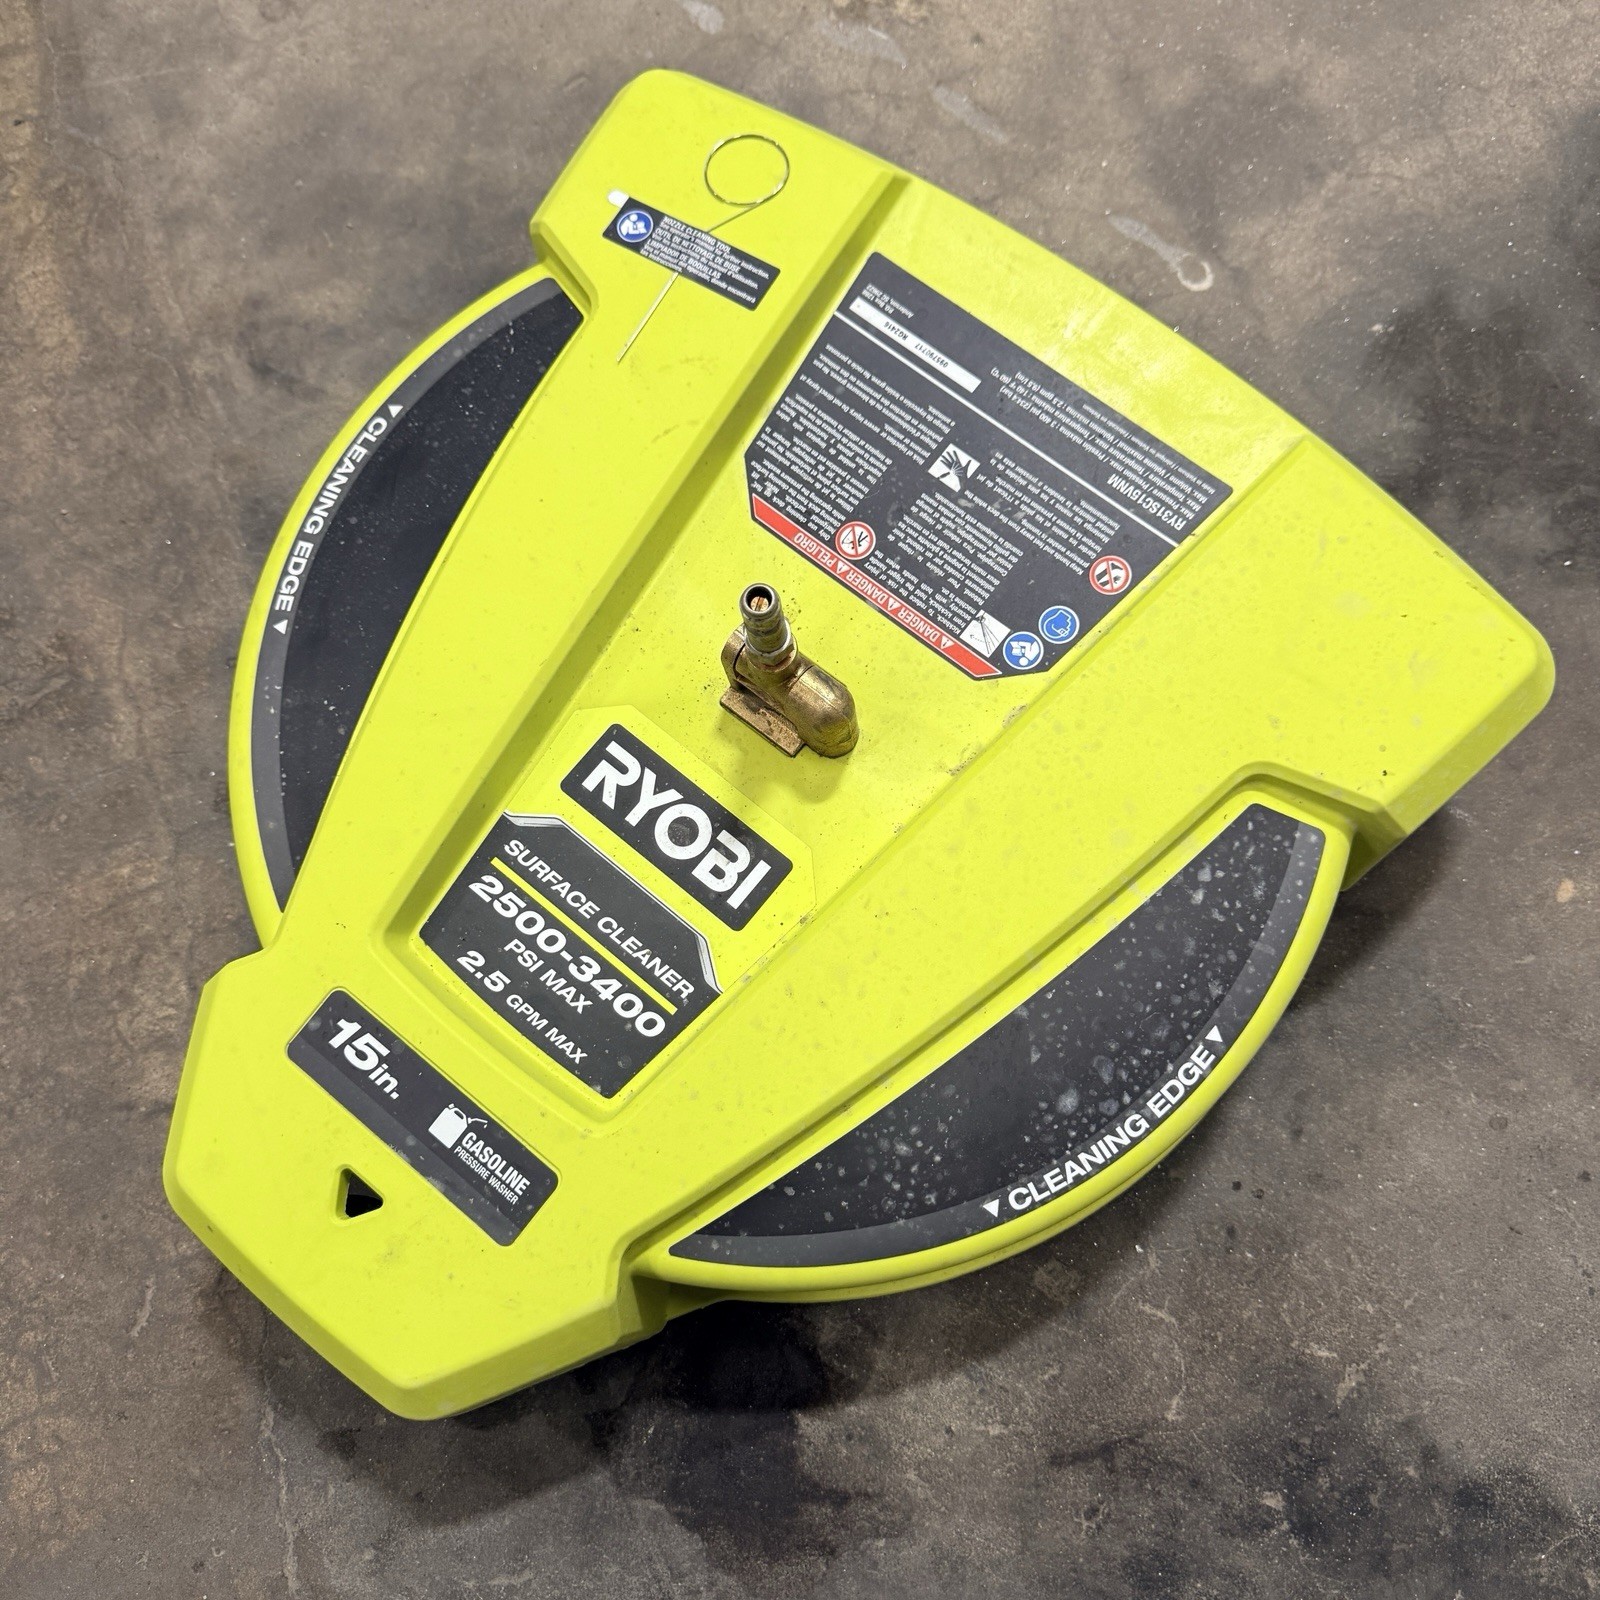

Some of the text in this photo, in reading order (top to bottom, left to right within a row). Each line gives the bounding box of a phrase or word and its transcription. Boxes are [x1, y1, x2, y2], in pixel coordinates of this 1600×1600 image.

[662, 216, 731, 254] NOZZLE CLEANING TOOL
[654, 227, 740, 273] OUTIL DE NETTOYAGE DE BUSE
[890, 298, 914, 318] Anderson,
[805, 378, 820, 391] spray
[1015, 371, 1029, 385] l/m)
[818, 388, 834, 401] direct
[999, 385, 1014, 398] bar)
[1016, 385, 1029, 396] 140
[1039, 388, 1055, 400] gpm
[832, 397, 843, 407] not
[841, 404, 850, 413] Do
[1011, 394, 1032, 410] (234.4
[1029, 406, 1042, 416] psi
[1031, 395, 1055, 414] máxima
[1052, 397, 1064, 408] 2.5
[849, 409, 865, 423] injury.
[1039, 413, 1052, 424] 400
[1054, 410, 1090, 438] Temperatura
[1065, 406, 1090, 425] máxima
[863, 419, 880, 433] severe
[884, 423, 905, 440] animals.
[1059, 426, 1084, 445] máxima
[1089, 421, 1115, 443] Volumen
[886, 435, 908, 453] injection
[905, 449, 914, 457] of
[909, 441, 931, 458] persons
[1082, 441, 1106, 460] Presión
[1095, 437, 1110, 450] max.
[1116, 441, 1145, 461] maximal
[912, 453, 925, 465] Risk
[1108, 447, 1145, 475] Température
[1109, 459, 1125, 472] max.
[1143, 458, 1166, 477] Volume
[768, 472, 789, 490] cleaning
[1123, 469, 1150, 490] Pression
[1148, 474, 1185, 502] Temperature
[1169, 475, 1192, 494] Volume
[762, 458, 846, 521] while operating the pressure washer.
[788, 487, 798, 497] the
[1193, 489, 1208, 504] Max.
[772, 496, 786, 507] deck
[785, 494, 807, 513] surfaces.
[796, 493, 809, 506] from
[807, 502, 821, 513] deck
[1107, 474, 1186, 530] RY31SC15VNM
[1152, 489, 1180, 510] Pressure
[1186, 498, 1202, 512] Max.
[275, 417, 387, 612] CLEANING EDGE
[785, 505, 807, 523] cleaning
[819, 509, 841, 528] cleaning
[1180, 506, 1195, 520] Max.
[807, 521, 818, 531] use
[810, 514, 836, 535] horizontal
[964, 490, 1084, 576] Keep hands and feet away from the deck while the
[818, 529, 831, 541] Only
[1021, 518, 1090, 568] pressure washer is running.
[794, 532, 837, 567] PELIGRO
[863, 562, 881, 576] injury
[846, 570, 888, 604] DANGER
[869, 556, 967, 628] from kickback, hold the trigger handle
[874, 550, 972, 621] securely with both hands when the
[887, 579, 899, 589] risk
[898, 587, 909, 597] the
[909, 594, 928, 610] reduce
[941, 586, 977, 615] machine is on.
[927, 608, 935, 617] To
[898, 607, 941, 642] DANGER
[937, 614, 961, 635] Kickback.
[581, 740, 772, 910] RYOBI
[503, 838, 695, 1000] SURFACE CLEANER
[468, 874, 666, 1038] 2500-3400
[503, 938, 594, 1014] PSI MAX
[456, 950, 589, 1065] 2.5 GPM MAX
[1008, 1045, 1216, 1211] CLEANING EDGE
[461, 1132, 531, 1196] GASOLINE
[453, 1146, 519, 1205] PRESSURE WASHER
